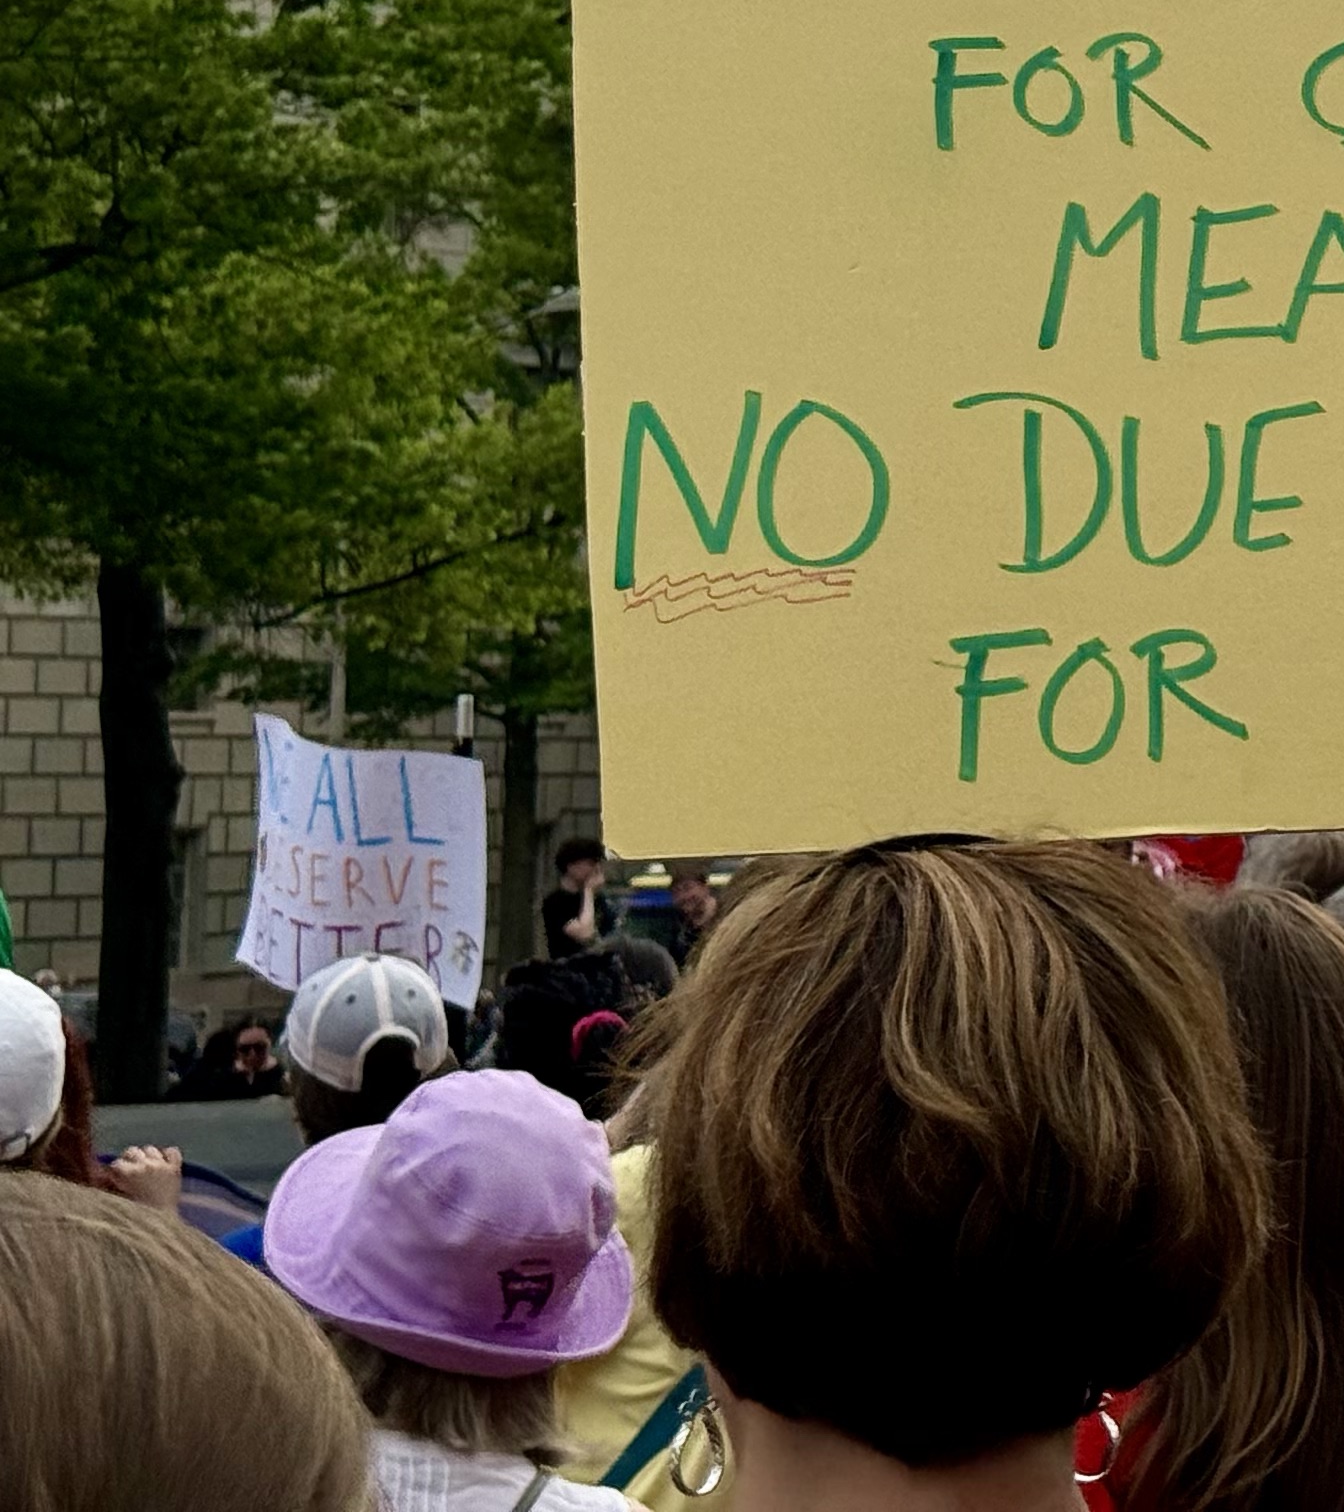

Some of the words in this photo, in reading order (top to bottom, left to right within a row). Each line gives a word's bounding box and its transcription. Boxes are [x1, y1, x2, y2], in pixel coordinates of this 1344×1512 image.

[927, 31, 1212, 152] FOR
[614, 388, 892, 590] NO
[952, 391, 1328, 574] DUE
[936, 627, 1250, 781] FOR
[307, 753, 446, 846] ALL
[258, 832, 450, 912] SERVE
